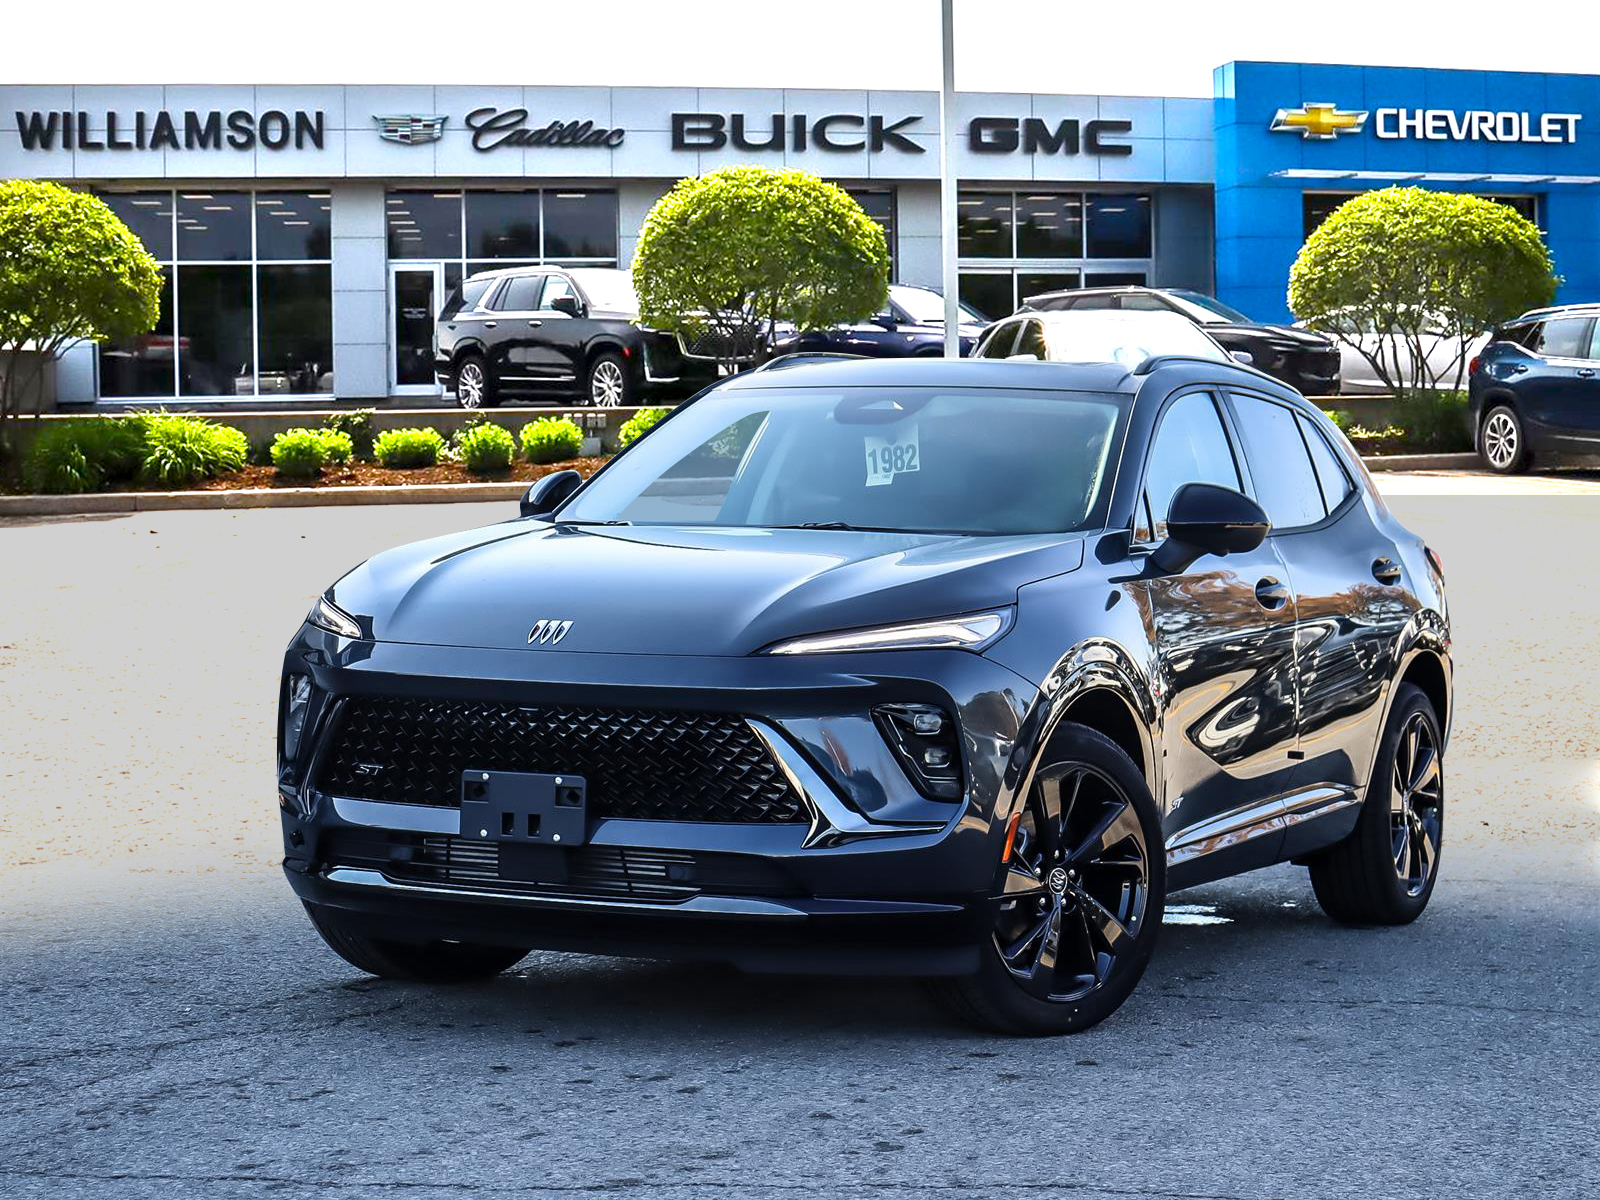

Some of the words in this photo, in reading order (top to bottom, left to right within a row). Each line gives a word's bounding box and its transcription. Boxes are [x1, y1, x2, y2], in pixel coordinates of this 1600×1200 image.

[15, 110, 324, 150] WILLIAMSON
[465, 108, 625, 151] Cadillac
[671, 113, 926, 153] BUICK
[969, 116, 1132, 155] GMC
[1376, 108, 1582, 143] CHEVROLET
[868, 444, 918, 474] 1982
